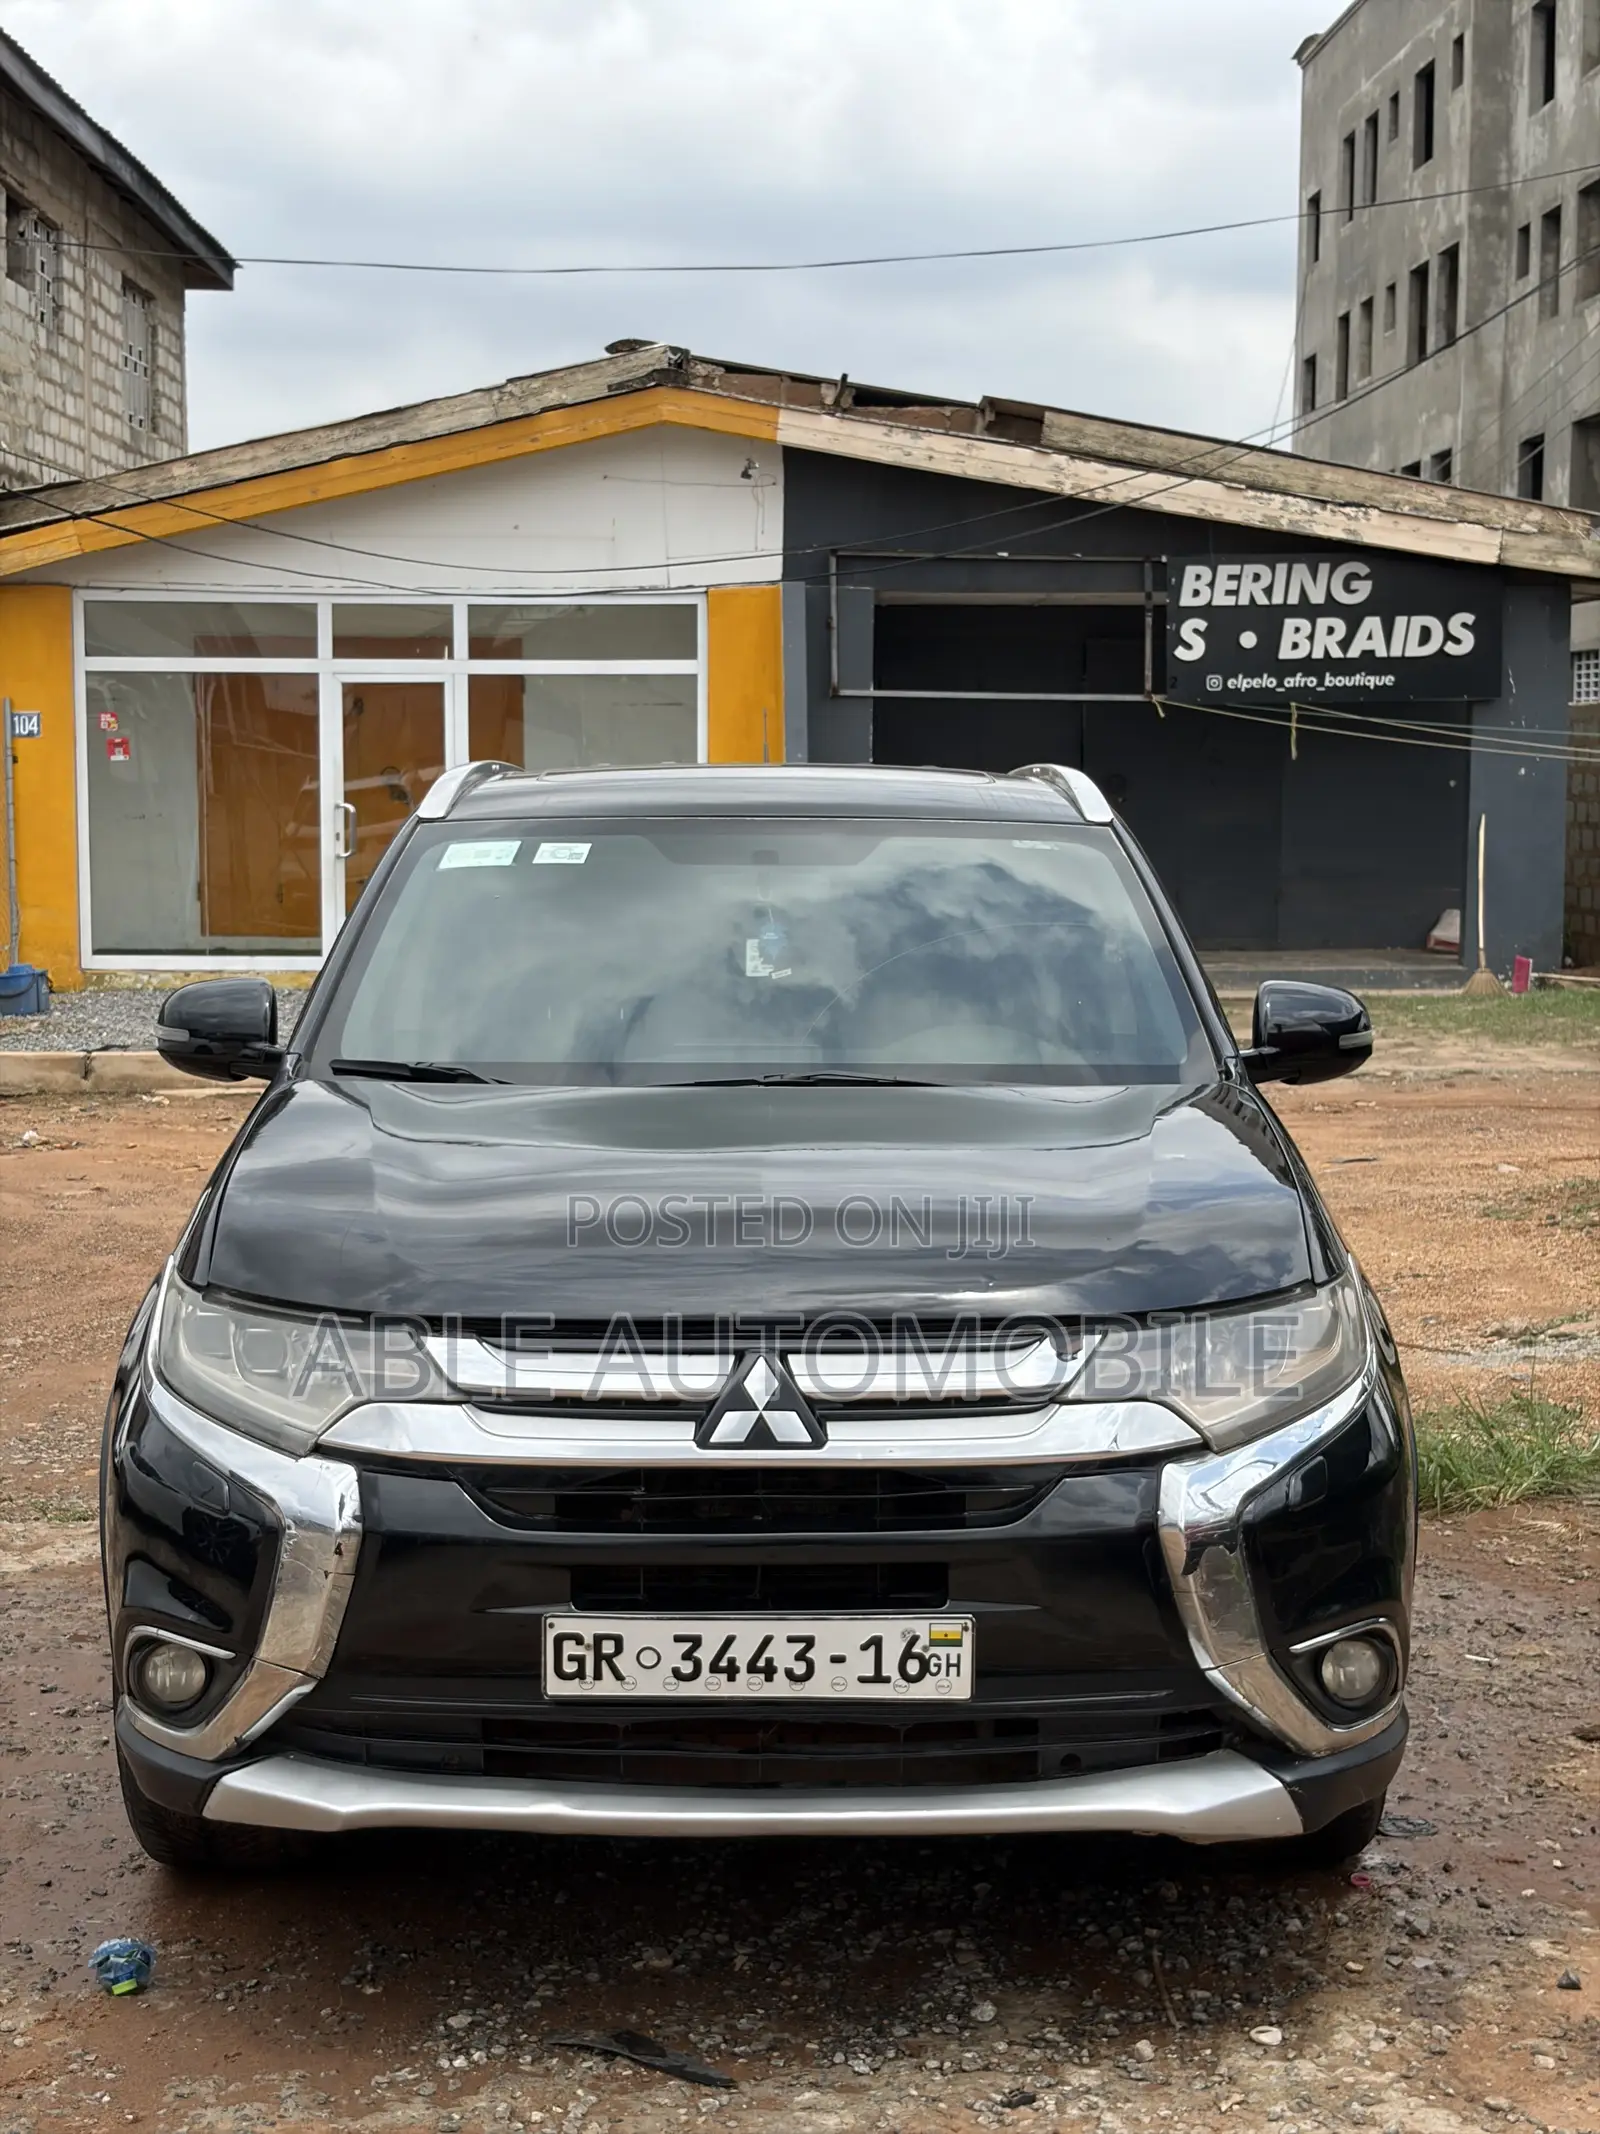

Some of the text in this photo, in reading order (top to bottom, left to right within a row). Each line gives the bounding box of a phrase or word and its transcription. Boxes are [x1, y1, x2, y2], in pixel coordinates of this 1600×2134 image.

[1179, 561, 1373, 607] BERING
[1173, 612, 1477, 661] S BRAIDS
[1226, 671, 1395, 692] elpelo_afro_boutique
[13, 714, 39, 735] 104
[553, 1632, 626, 1681] GR
[927, 1652, 962, 1678] GH
